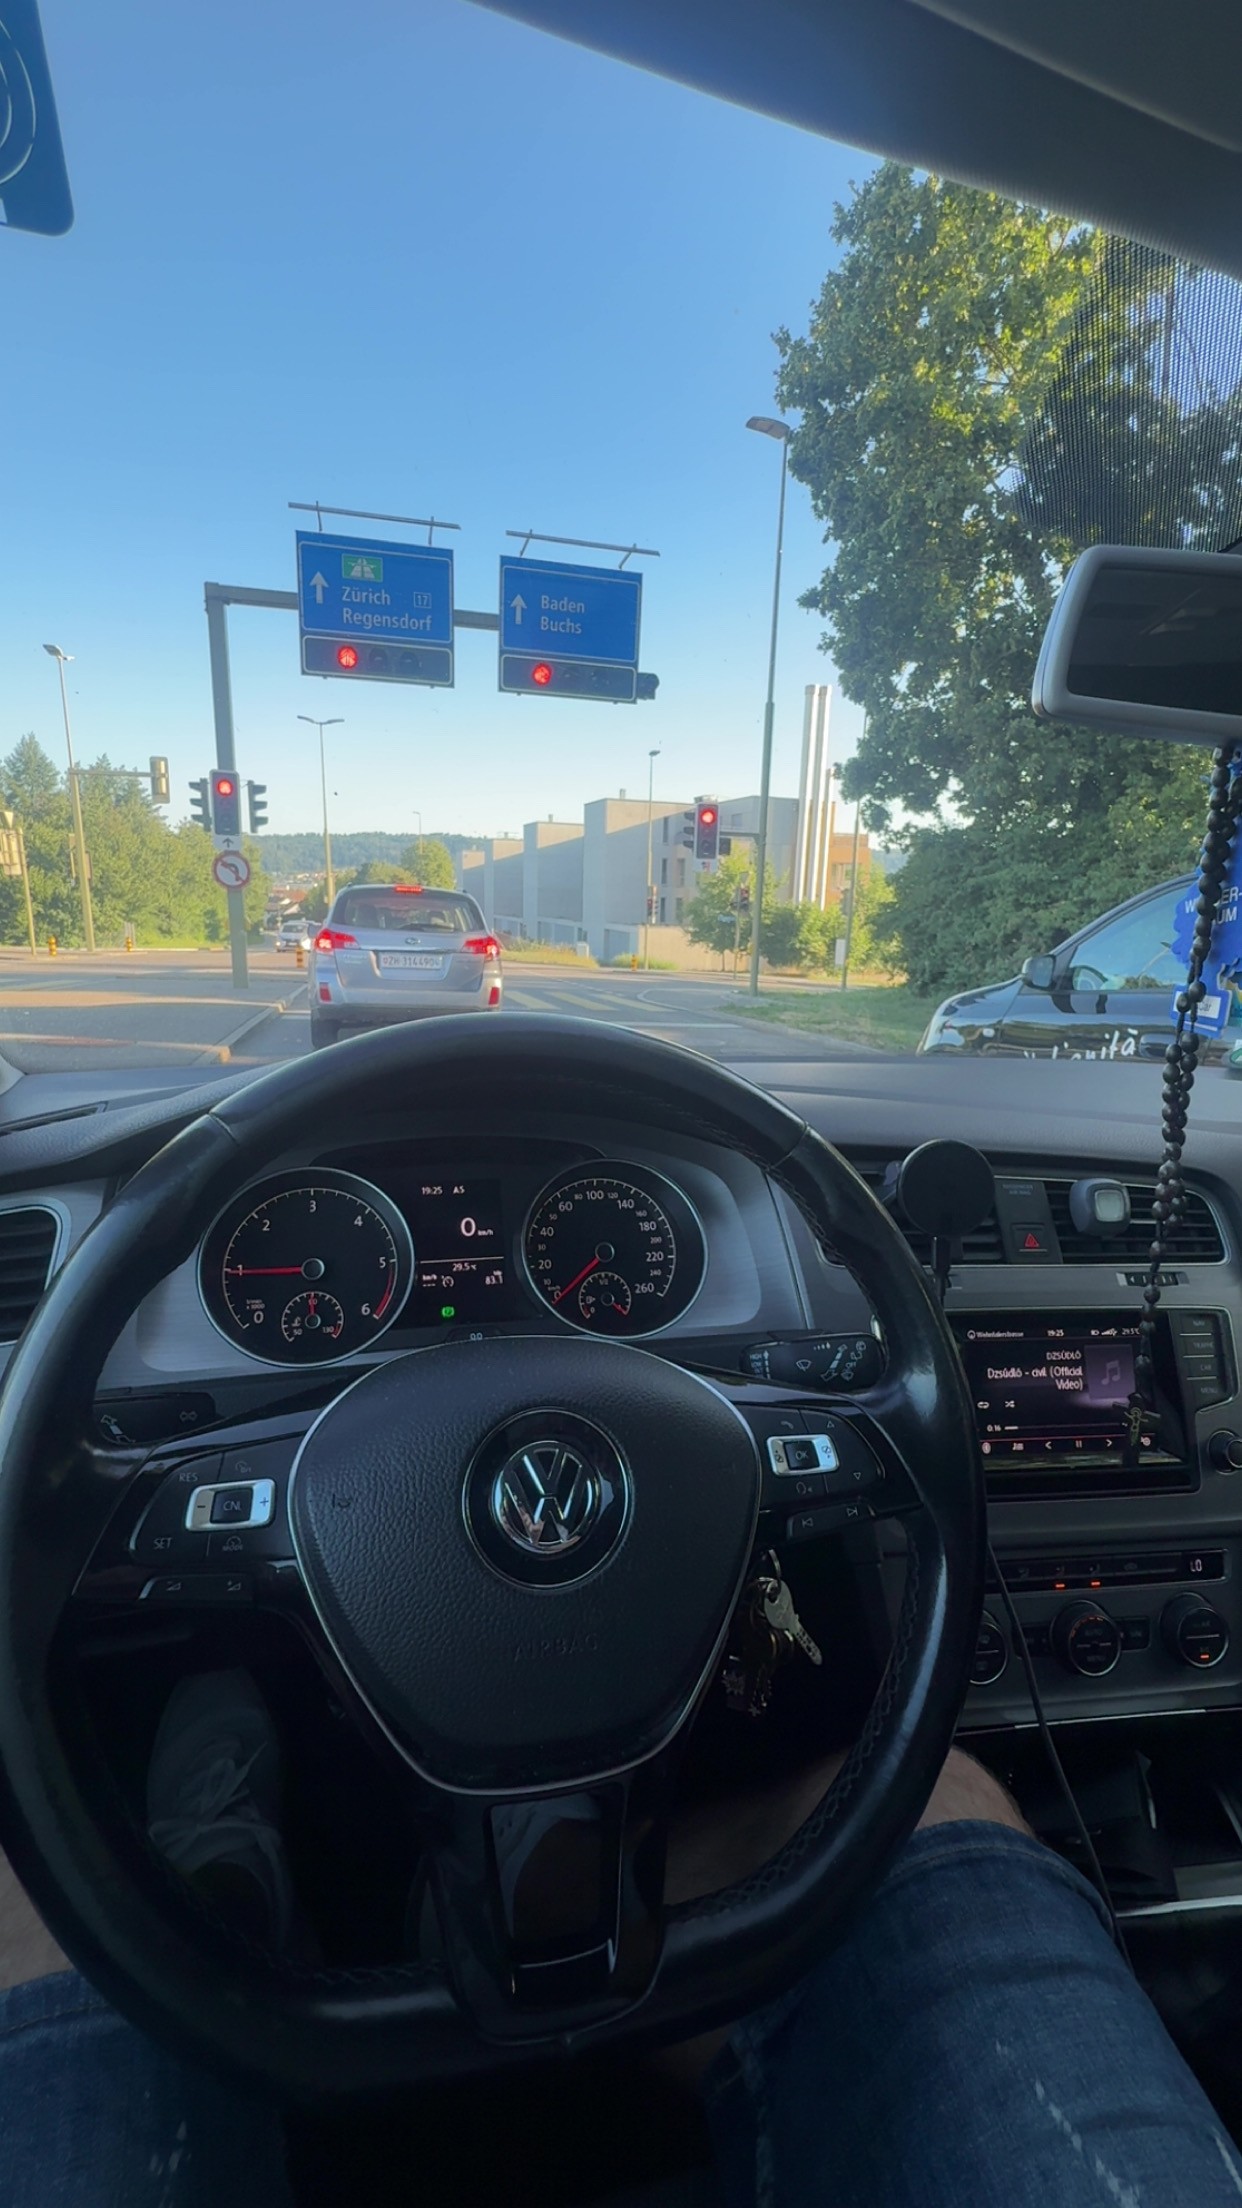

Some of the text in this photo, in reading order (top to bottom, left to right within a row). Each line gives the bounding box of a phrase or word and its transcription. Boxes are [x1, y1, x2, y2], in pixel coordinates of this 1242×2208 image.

[342, 586, 391, 607] Zürich
[416, 595, 429, 607] 17
[541, 595, 585, 614] Baden
[343, 608, 432, 631] Regensdorf
[540, 616, 582, 635] Buchs
[422, 1186, 443, 1195] 19:25
[586, 1190, 604, 1201] 100
[309, 1200, 317, 1213] 3
[558, 1201, 573, 1212] 60
[617, 1199, 635, 1210] 140
[262, 1220, 270, 1231] 2
[354, 1215, 363, 1226] 4
[461, 1217, 476, 1237] 0
[540, 1227, 554, 1237] 40
[639, 1221, 657, 1232] 180
[379, 1256, 386, 1268] 5
[646, 1251, 664, 1262] 220
[538, 1259, 551, 1270] 20
[635, 1283, 655, 1294] 260
[361, 1303, 370, 1315] 6
[254, 1311, 264, 1324] 0
[1055, 1379, 1083, 1391] Video)
[795, 1450, 809, 1461] OK
[179, 1472, 198, 1482] RES
[223, 1500, 241, 1511] CNL
[153, 1537, 173, 1550] SET
[1190, 1559, 1202, 1572] LO
